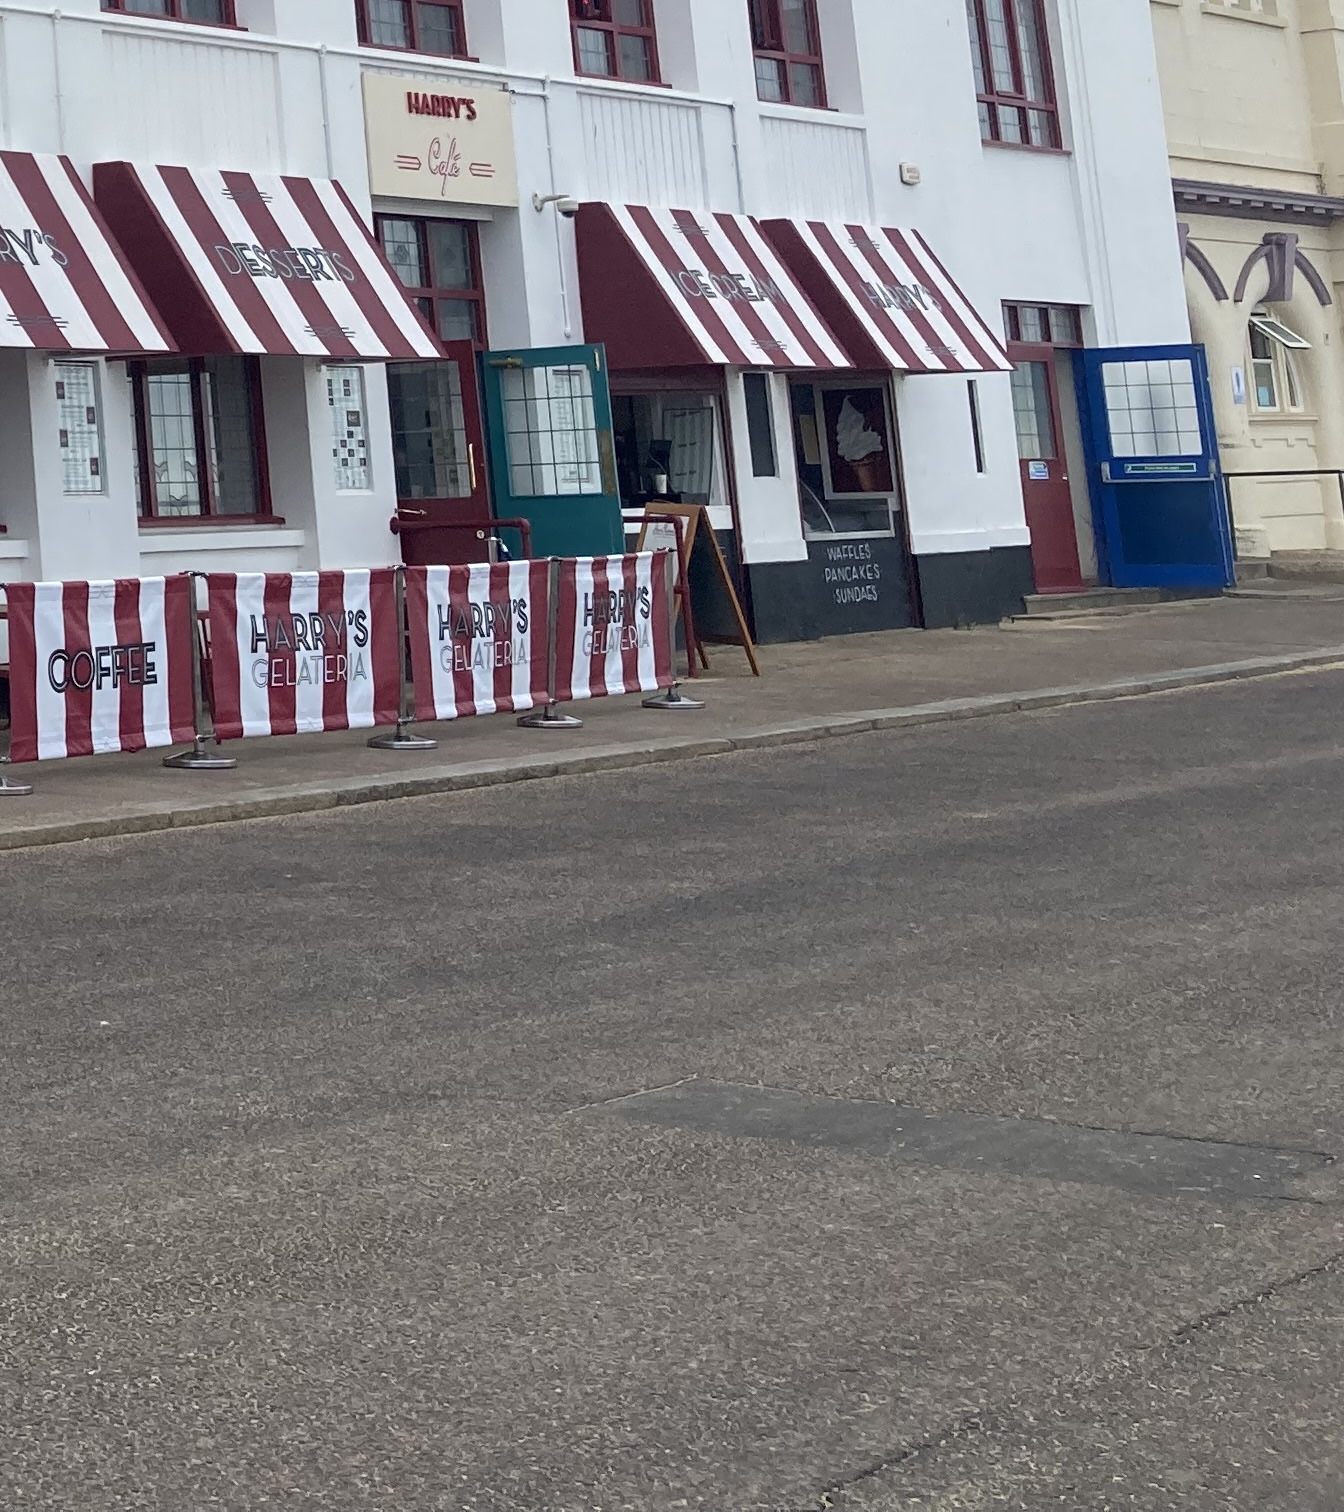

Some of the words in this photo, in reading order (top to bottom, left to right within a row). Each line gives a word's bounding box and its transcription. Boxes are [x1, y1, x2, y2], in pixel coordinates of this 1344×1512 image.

[405, 91, 477, 121] HARRY'S
[428, 137, 461, 197] Café
[214, 242, 358, 282] DESSERTS
[669, 268, 718, 299] ICE
[707, 273, 790, 306] CREAM
[859, 281, 943, 312] HARRY'S
[827, 543, 872, 561] WAFFLES
[824, 564, 881, 583] PANCAKES
[583, 586, 651, 627] HARRY'S
[835, 585, 878, 604] SUNDAES
[250, 609, 369, 655] HARRY'S
[437, 597, 529, 641] HARRY'S
[582, 618, 651, 657] GELATERIA
[47, 642, 159, 693] COFFEE
[251, 655, 368, 689] GELATERIA
[439, 637, 528, 674] GELATERIA
